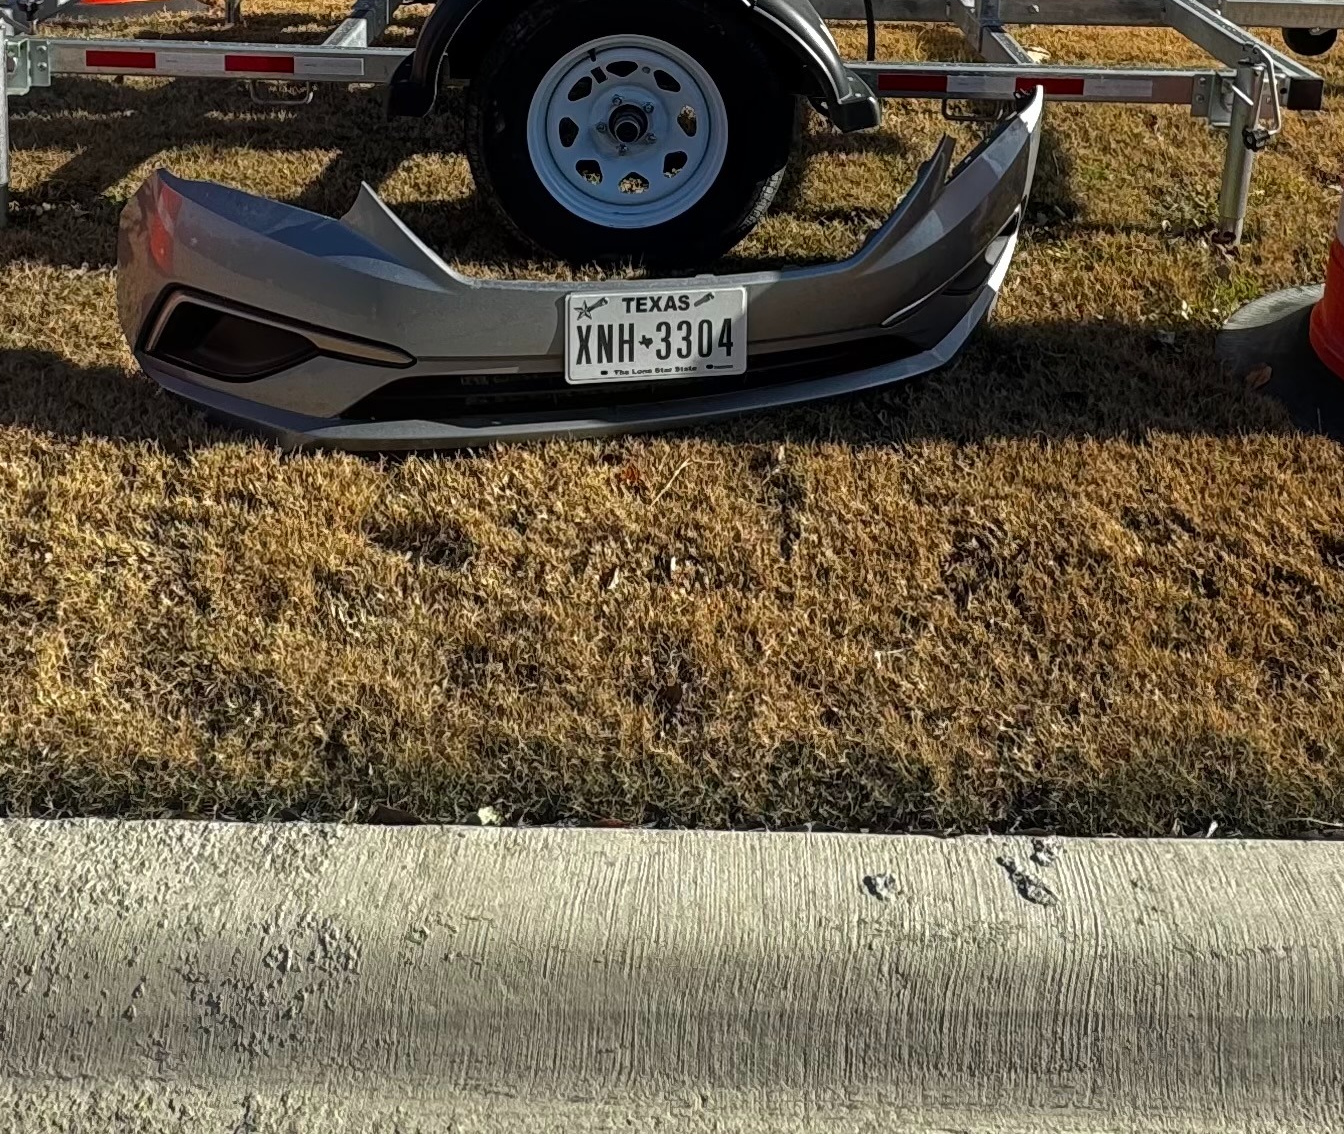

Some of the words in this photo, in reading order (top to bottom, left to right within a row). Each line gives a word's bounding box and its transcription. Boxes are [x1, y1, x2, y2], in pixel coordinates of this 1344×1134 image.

[622, 294, 691, 314] TEXAS
[575, 323, 635, 365] XNH
[655, 318, 734, 360] 3304
